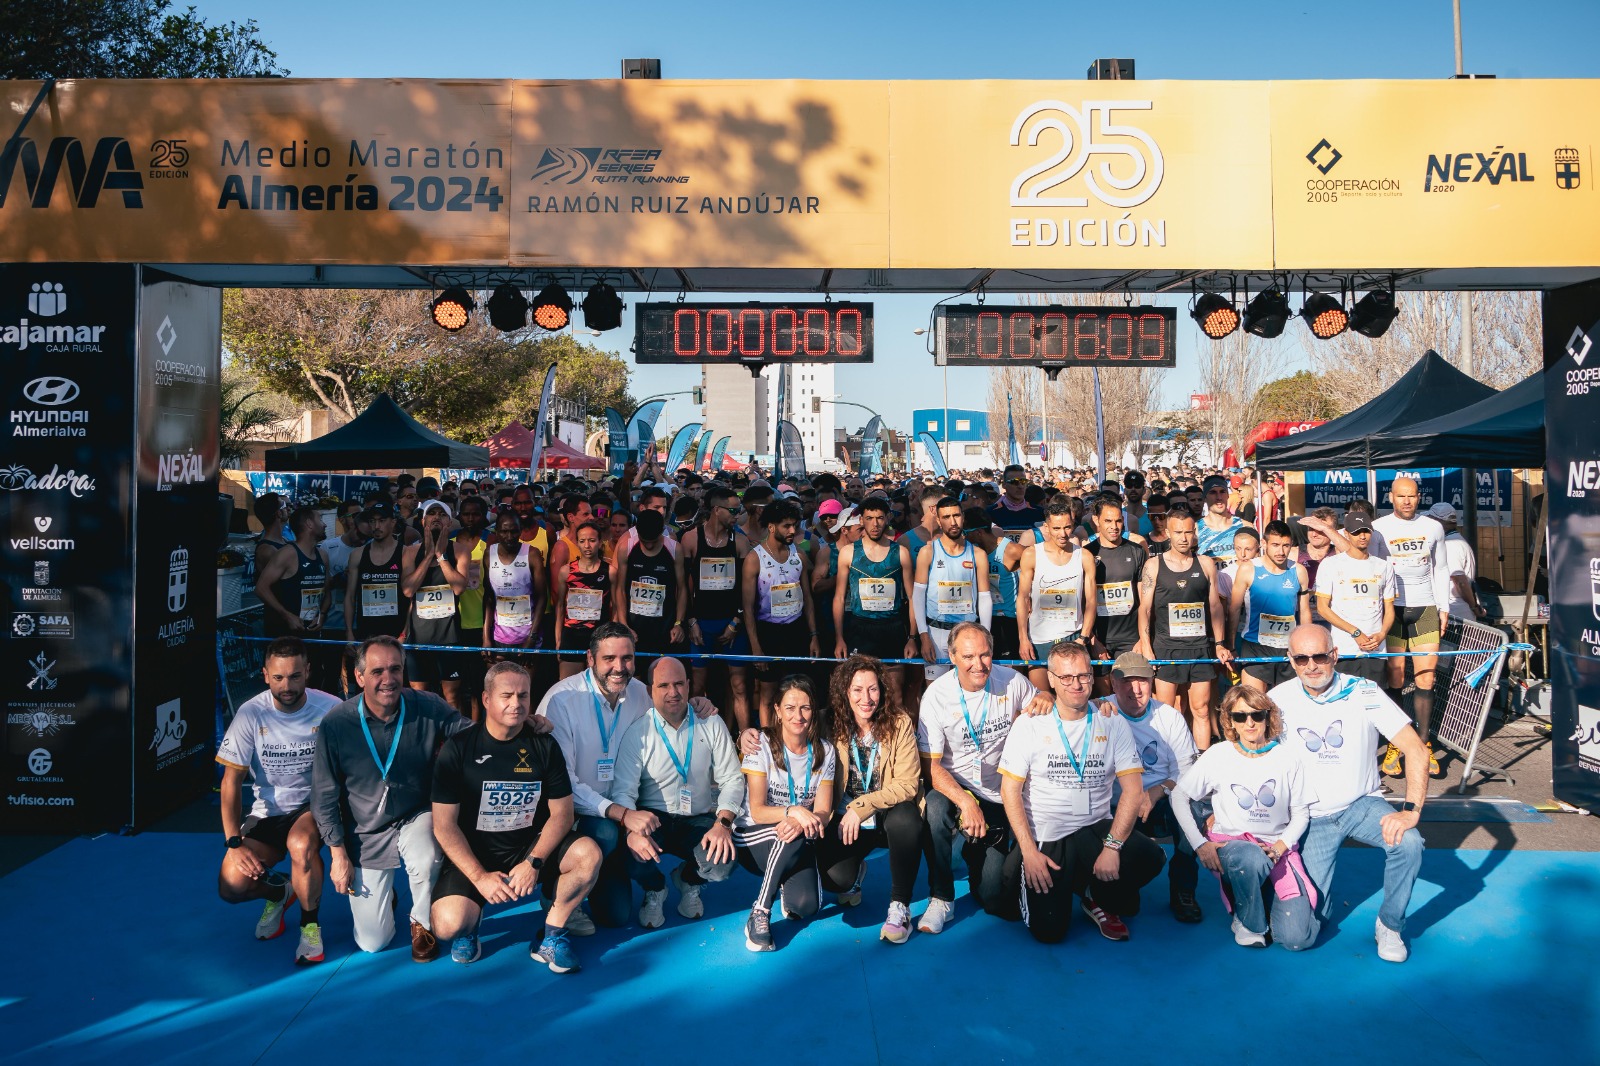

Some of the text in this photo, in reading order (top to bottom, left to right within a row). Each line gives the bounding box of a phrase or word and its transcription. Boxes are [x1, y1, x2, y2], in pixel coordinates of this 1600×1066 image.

[149, 139, 189, 168] 25
[220, 140, 504, 169] Medio Maratón
[1009, 99, 1165, 208] 25
[149, 169, 189, 179] EDICIÓN
[595, 163, 656, 173] SERIES
[1424, 146, 1535, 193] NEXAL
[591, 175, 690, 184] RUTA RUNNING
[1306, 178, 1400, 191] COOPERACIÓN
[217, 173, 504, 212] Almería 2024
[1433, 185, 1455, 193] 2020
[527, 191, 820, 214] RAMÓN RUIZ ANDÚJAR
[1306, 191, 1338, 203] 2005
[1009, 213, 1166, 248] EDICIÓN
[46, 344, 103, 353] CAJA RURAL
[155, 359, 207, 378] COOPERACIÓN
[155, 372, 173, 387] 2005
[1566, 381, 1590, 396] 2005
[10, 410, 89, 423] HYUNDAI
[13, 425, 86, 437] Almerialva
[156, 447, 206, 492] NEXAL
[1571, 490, 1585, 498] 2020
[10, 538, 75, 551] vellsam
[1394, 540, 1424, 552] 1657
[711, 563, 726, 573] 17
[22, 587, 62, 595] DIPUTACIÓN
[372, 589, 386, 599] 19
[634, 587, 662, 600] 1275
[785, 589, 792, 599] 4
[870, 584, 885, 594] 12
[949, 586, 962, 597] 11
[1100, 587, 1129, 600] 1507
[1353, 583, 1369, 594] 10
[427, 591, 442, 602] 20
[577, 594, 591, 604] 13
[1054, 594, 1063, 605] 9
[508, 601, 516, 611] 7
[1173, 608, 1202, 620] 1468
[39, 615, 70, 626] SAFA
[1268, 620, 1290, 632] 775
[157, 615, 195, 640] ALMERÍA
[992, 719, 1012, 732] 2024
[261, 749, 298, 758] Almería
[7, 793, 75, 806] tufisio.com
[487, 791, 535, 807] 5926
